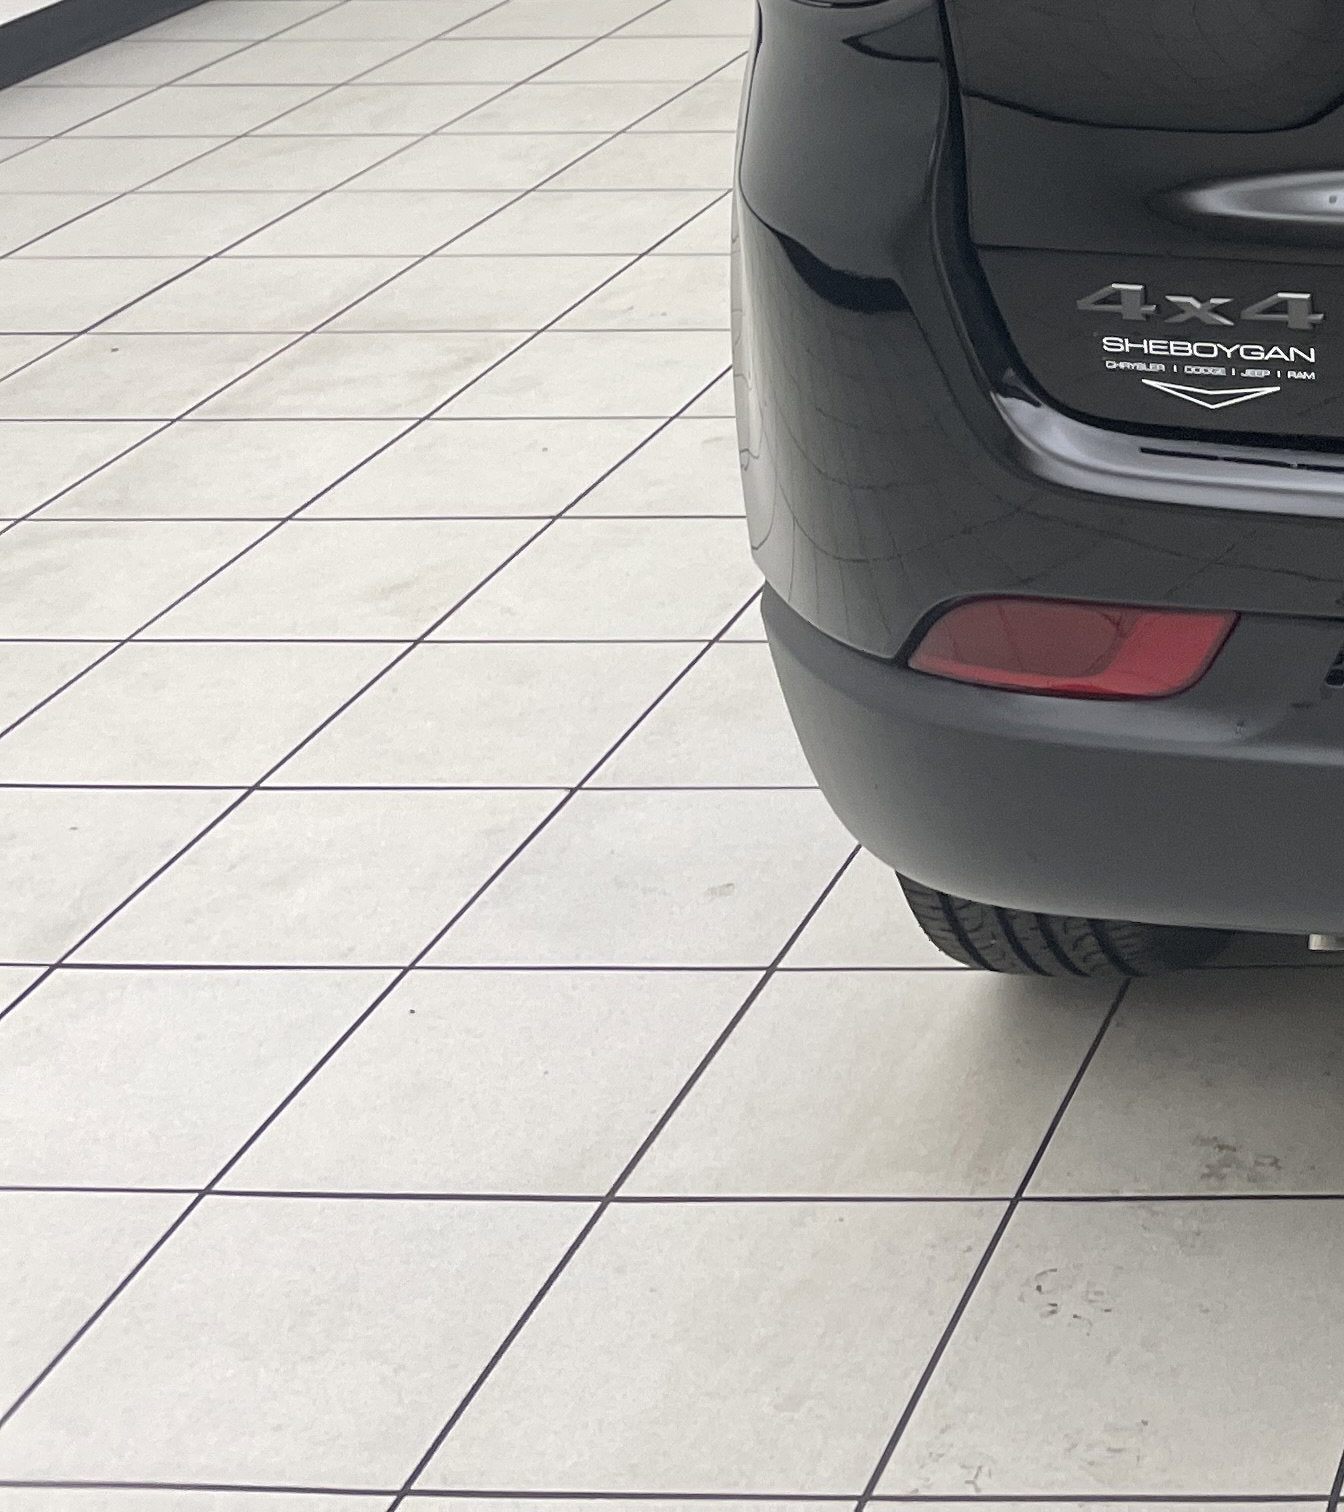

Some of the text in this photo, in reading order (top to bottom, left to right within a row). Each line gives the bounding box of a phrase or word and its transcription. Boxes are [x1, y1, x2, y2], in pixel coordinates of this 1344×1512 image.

[1076, 282, 1325, 330] 4x4
[1101, 336, 1316, 363] SHEBOYGAN
[1105, 360, 1316, 381] CHRYSLER DODGE JEEP RAM
